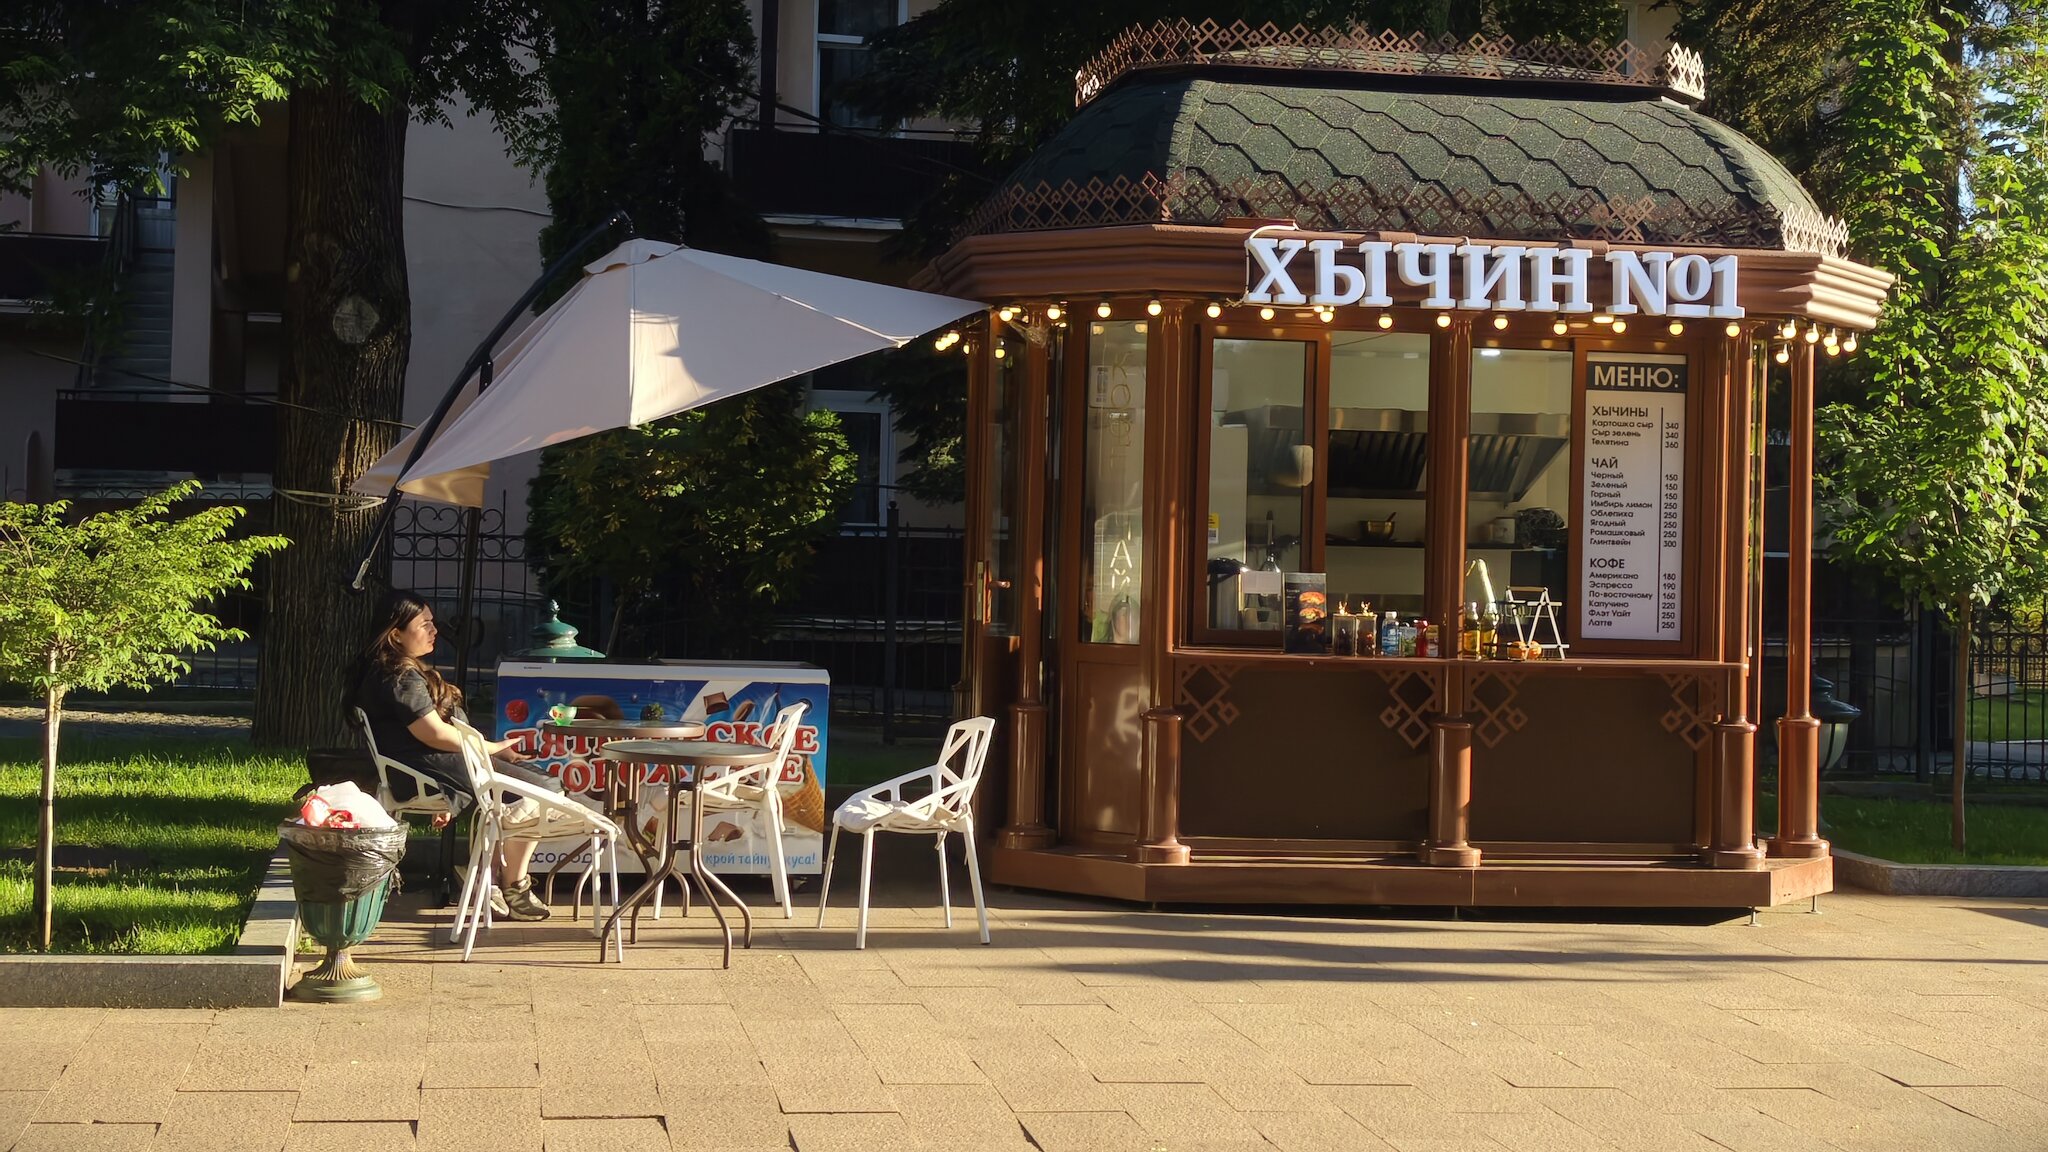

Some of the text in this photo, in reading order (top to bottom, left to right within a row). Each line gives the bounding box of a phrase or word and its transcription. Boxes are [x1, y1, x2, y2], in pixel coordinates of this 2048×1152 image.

[1244, 237, 1593, 313] ХЫЧИН
[1594, 365, 1679, 388] МЕНЮ:
[1592, 406, 1649, 417] ХЫЧИНЫ
[1592, 420, 1679, 430] Картошка сыр 340
[1592, 429, 1611, 437] Сыр
[1592, 438, 1629, 446] Телятина
[1592, 457, 1618, 469] ЧАЙ
[1591, 472, 1624, 480] Черный
[1591, 481, 1628, 489] Зеленый
[1591, 491, 1621, 499] Горный
[1591, 501, 1624, 509] Имбирь
[1590, 510, 1634, 518] Облепиха
[1590, 520, 1626, 528] Ягодный
[1590, 529, 1645, 537] Ромашковый
[1590, 538, 1631, 546] Глинтвейн
[1590, 558, 1625, 569] КОФЕ
[1589, 572, 1639, 580] Американо
[1589, 591, 1653, 600] По-восточному
[1589, 600, 1629, 609] Капучино
[1662, 612, 1675, 620] 250
[1588, 619, 1612, 627] Латте
[785, 852, 816, 868] куса!
